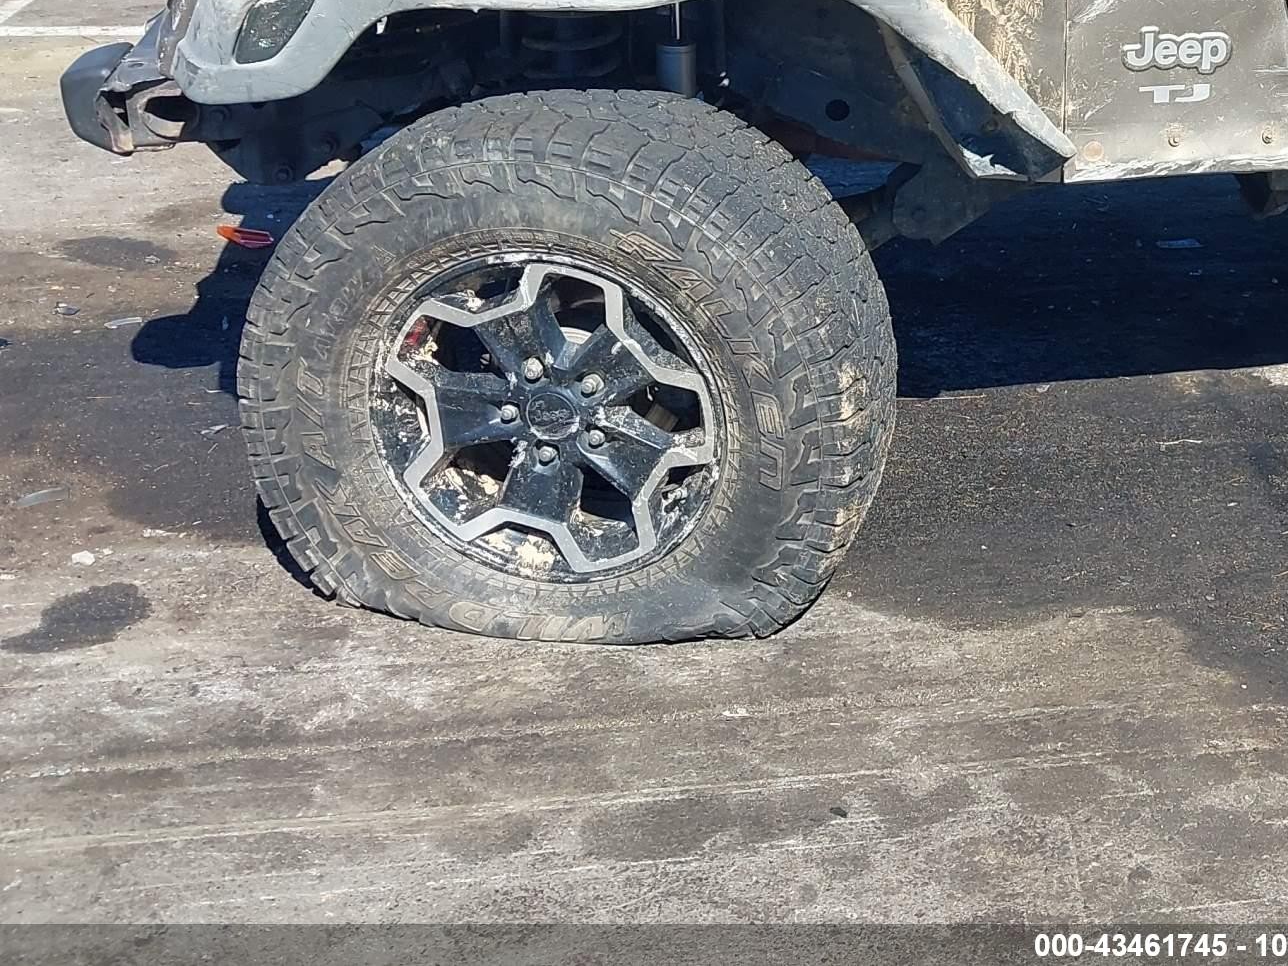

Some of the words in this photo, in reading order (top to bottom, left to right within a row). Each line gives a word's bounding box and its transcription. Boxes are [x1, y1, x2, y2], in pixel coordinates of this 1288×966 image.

[1123, 27, 1230, 72] Jeep
[1139, 84, 1211, 104] TJ
[609, 228, 785, 492] FALKEN
[314, 478, 634, 642] WILDPEAK
